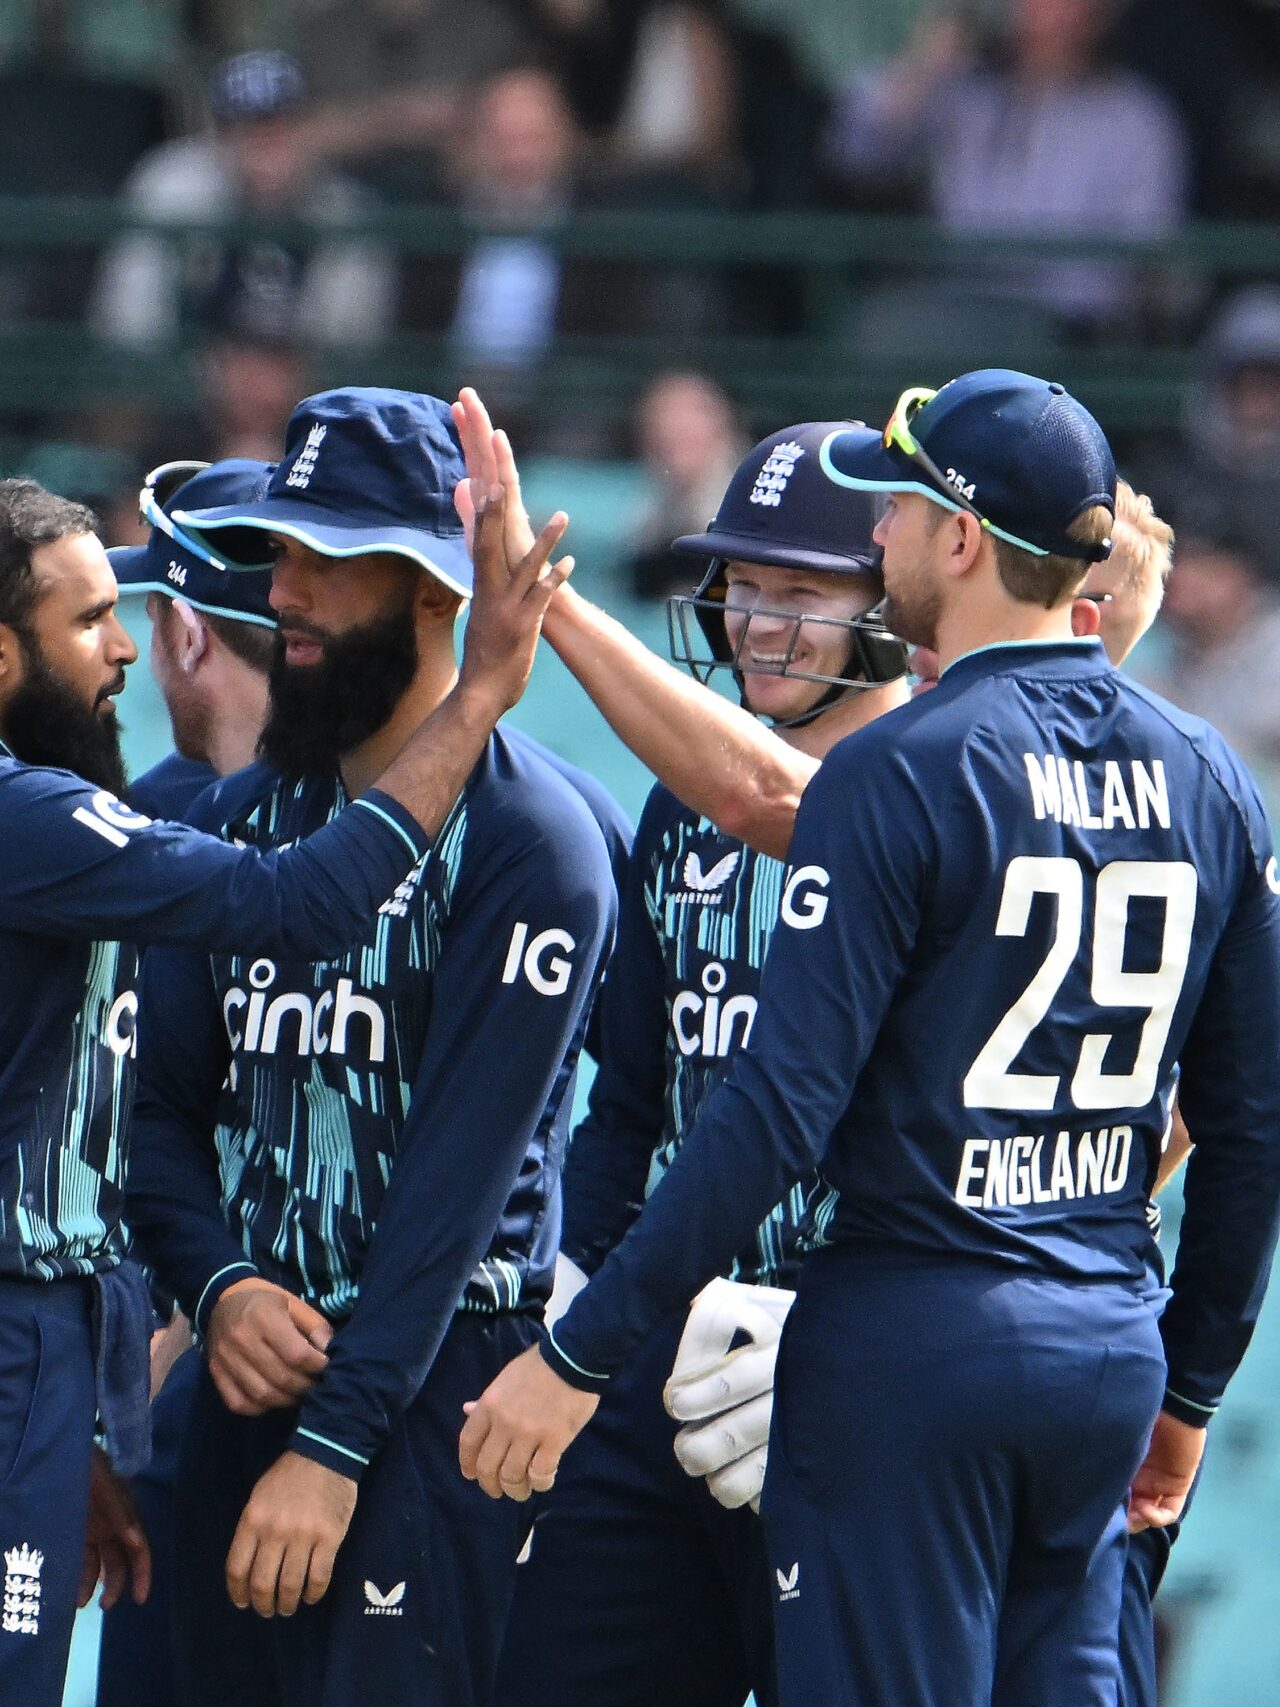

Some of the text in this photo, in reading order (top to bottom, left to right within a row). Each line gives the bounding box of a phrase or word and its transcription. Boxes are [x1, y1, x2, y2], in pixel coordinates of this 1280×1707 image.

[946, 467, 976, 500] 254
[167, 560, 188, 587] 244
[1024, 753, 1172, 830] MALAN
[781, 864, 831, 930] G
[502, 922, 576, 996] IG
[964, 856, 1198, 1111] 29
[223, 957, 385, 1062] cinch
[955, 1125, 1133, 1208] ENGLAND
